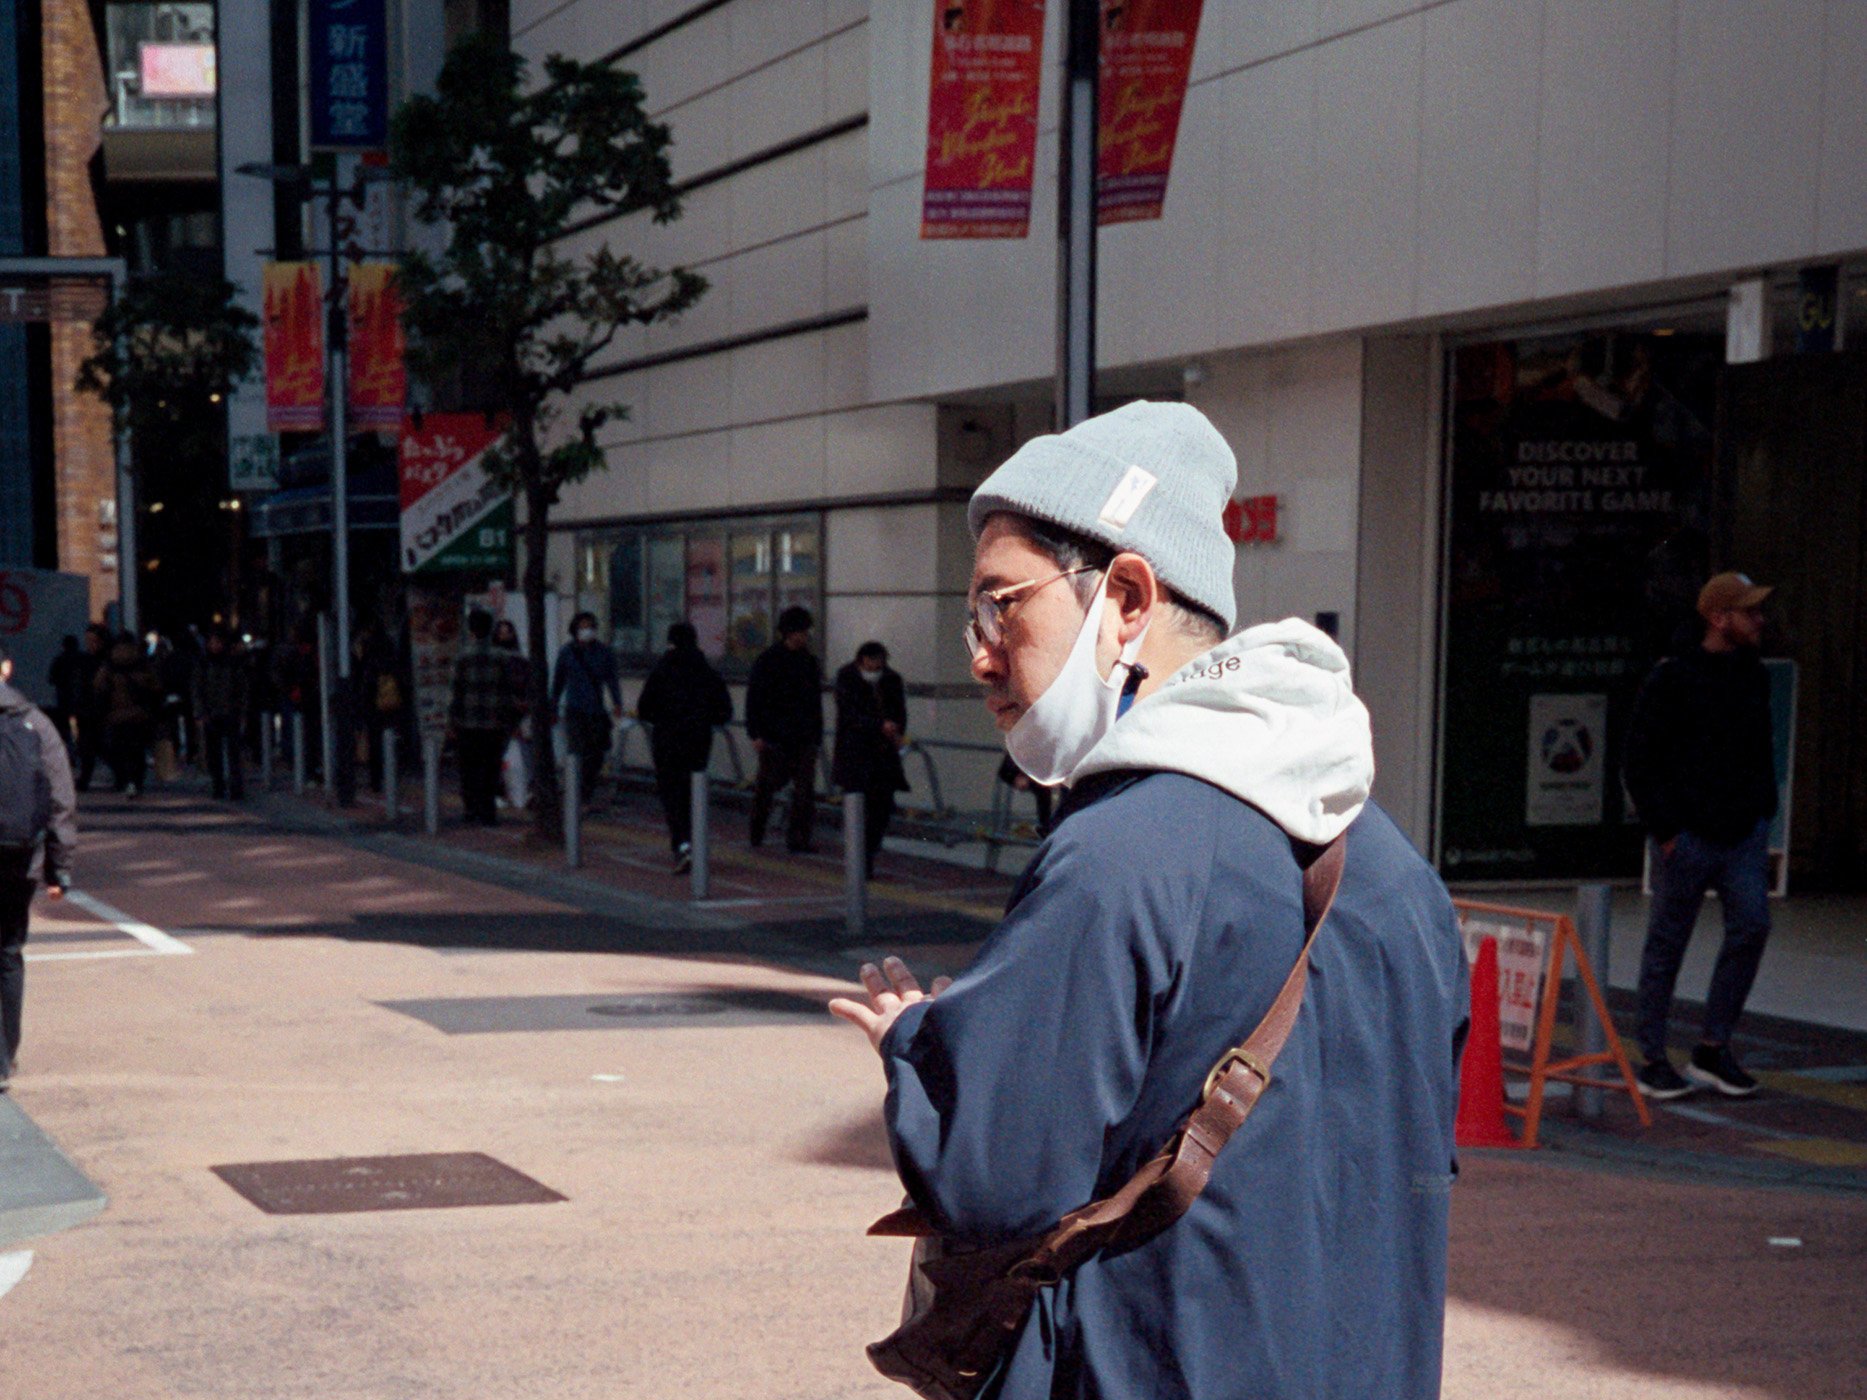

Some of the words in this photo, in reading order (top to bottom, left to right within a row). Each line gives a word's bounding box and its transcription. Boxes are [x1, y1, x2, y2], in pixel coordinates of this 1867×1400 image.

[1799, 291, 1833, 331] GU
[1517, 440, 1639, 463] DISCOVER
[1507, 465, 1575, 488] YOUR
[1581, 465, 1647, 488] NEXT
[1478, 490, 1595, 513] FAVORITE
[1600, 490, 1675, 513] GAME
